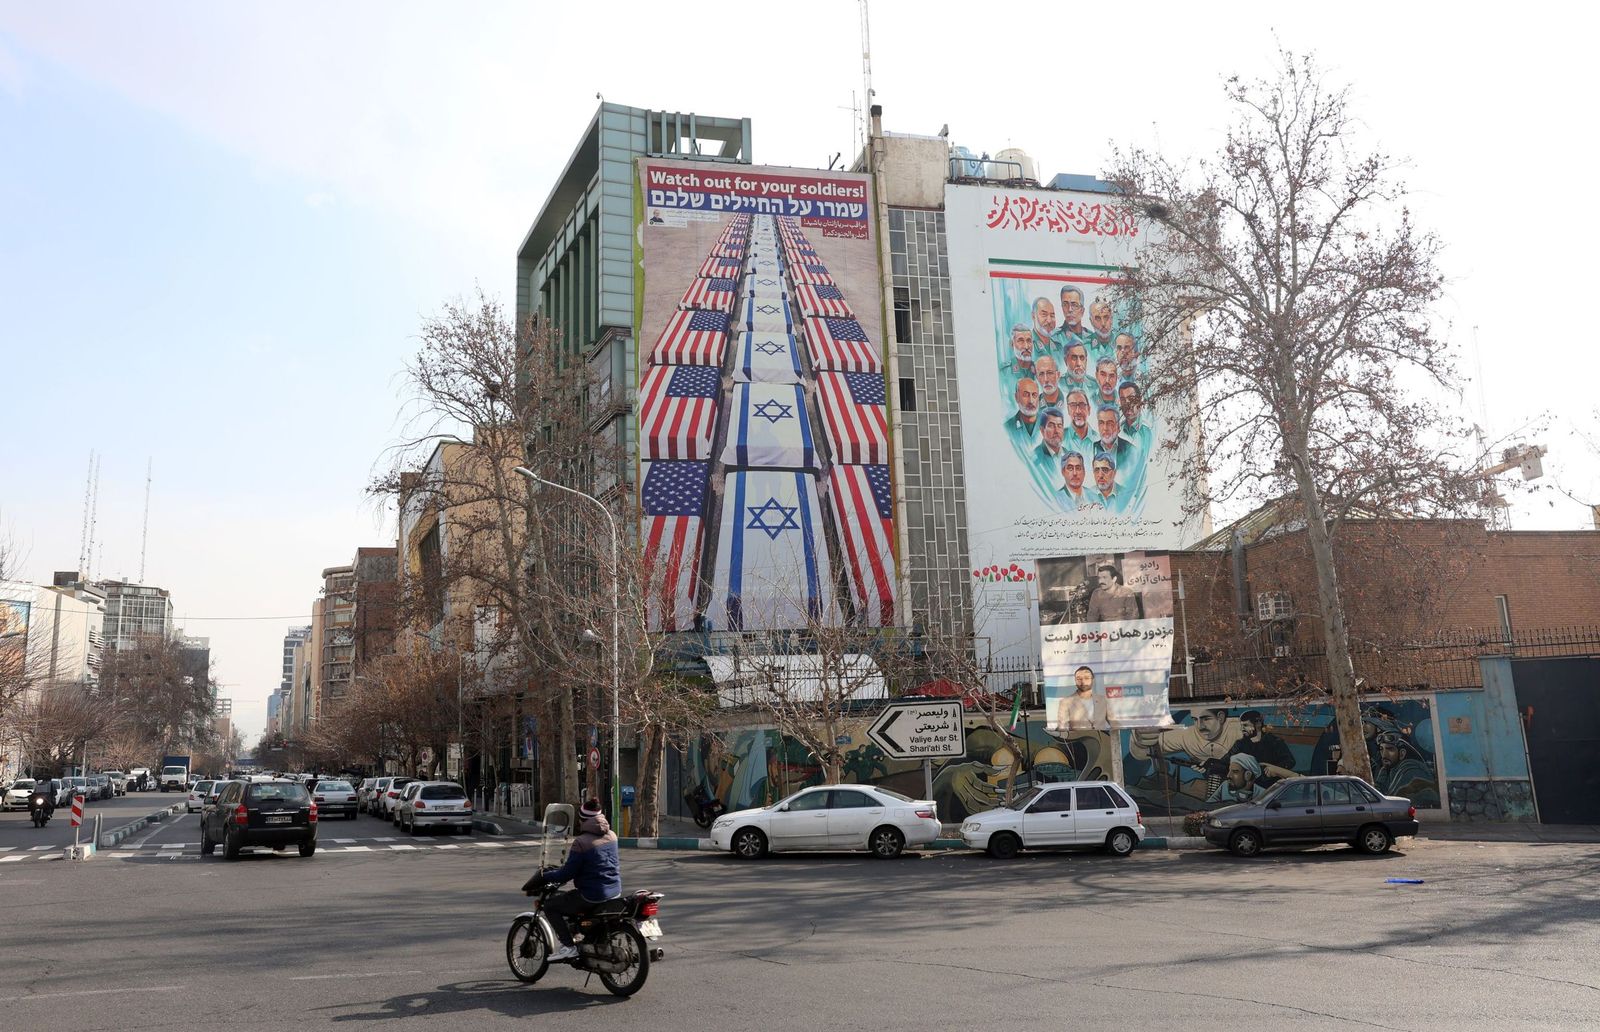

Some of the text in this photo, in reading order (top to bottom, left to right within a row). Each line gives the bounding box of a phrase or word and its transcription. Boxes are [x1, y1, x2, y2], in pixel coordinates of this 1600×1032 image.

[650, 171, 864, 198] Watch out for your soldiers!
[651, 188, 864, 218] שמרו על החיילים שלכם
[1140, 561, 1159, 571] رادیو
[1127, 574, 1149, 586] آزادی
[1044, 626, 1174, 643] مزدور همان مزدور است
[916, 708, 949, 719] ولیعصر
[915, 721, 949, 733] شریعتی
[949, 734, 959, 742] St.
